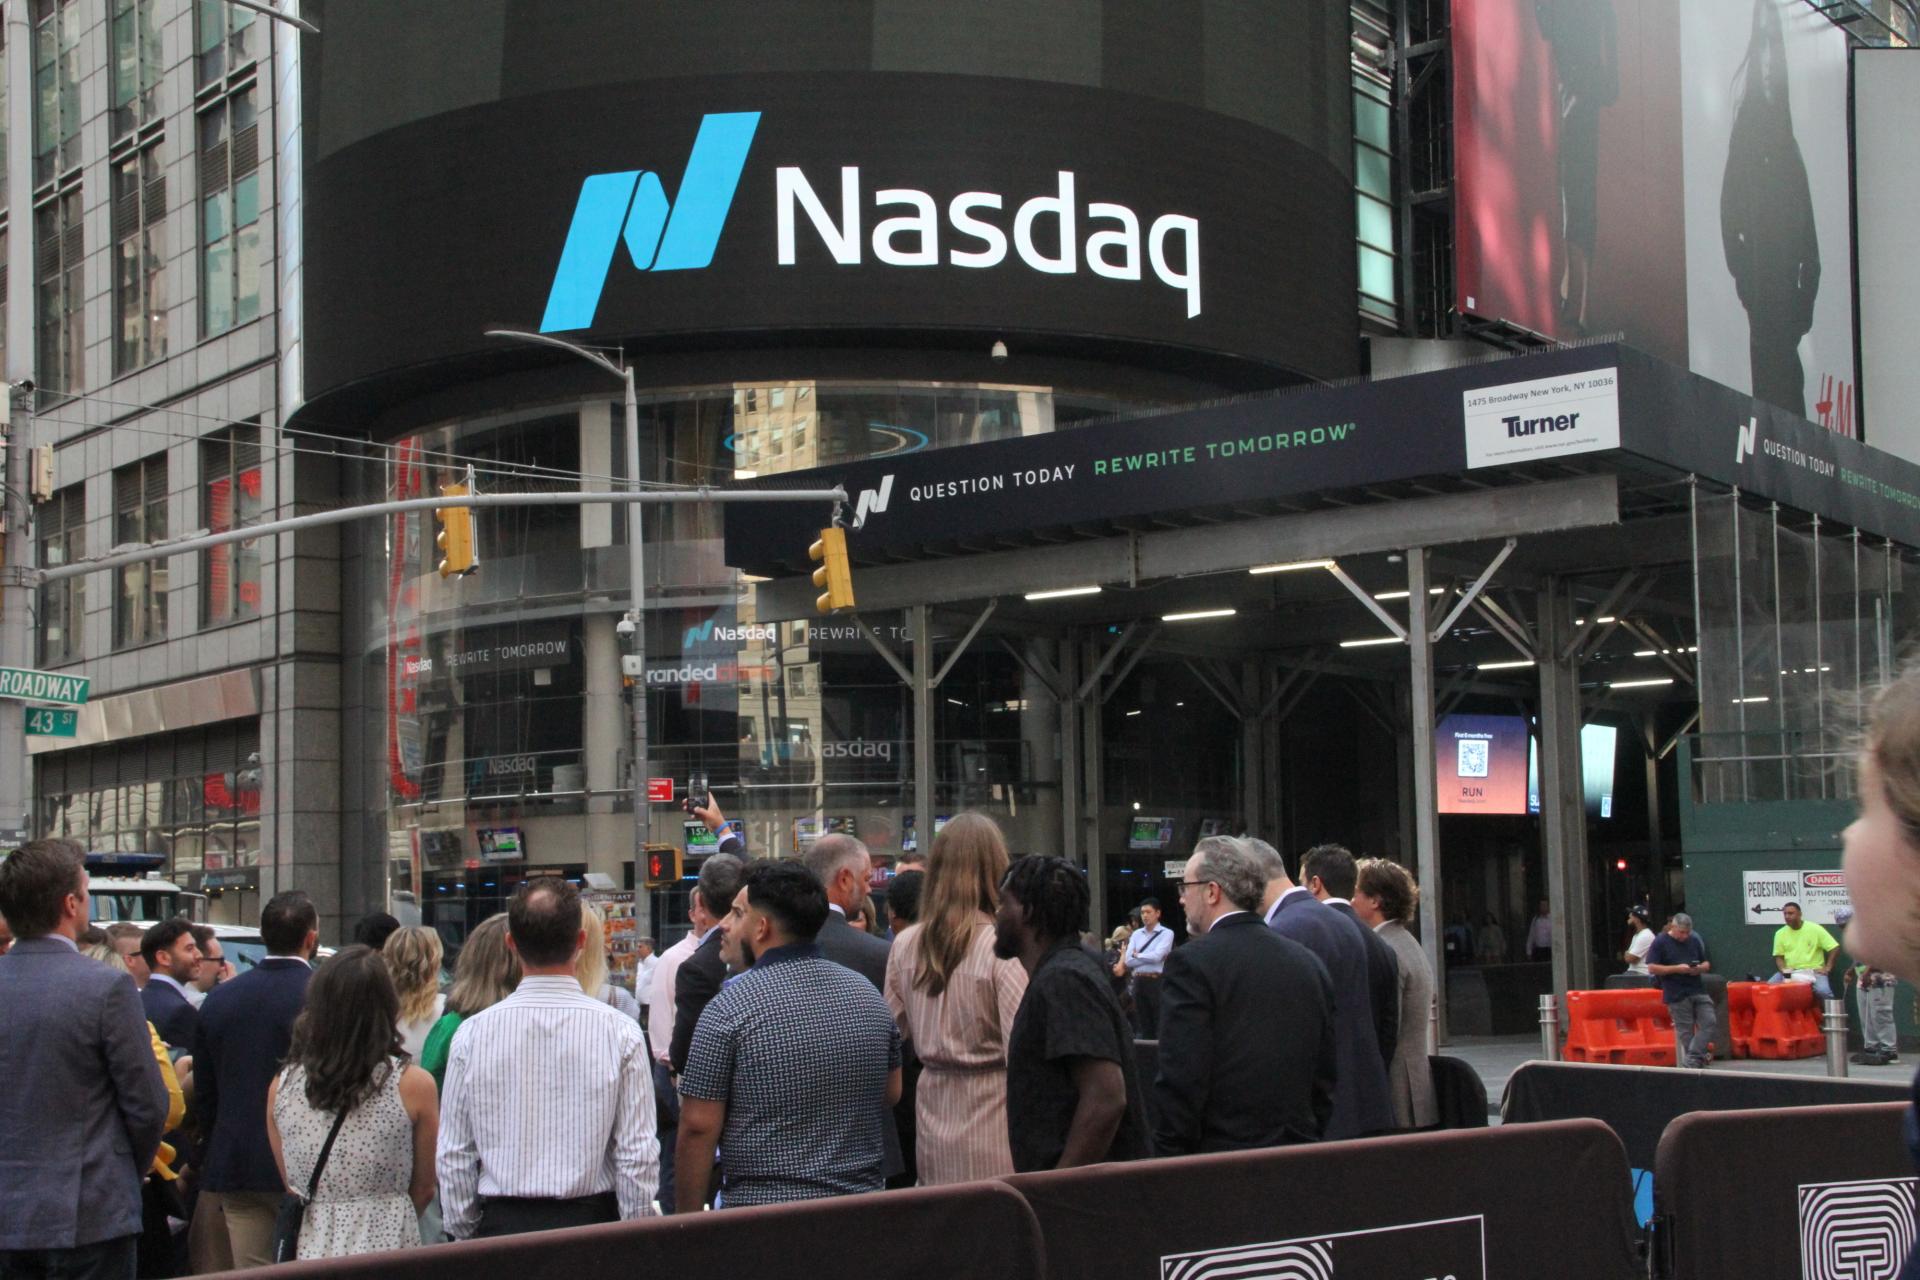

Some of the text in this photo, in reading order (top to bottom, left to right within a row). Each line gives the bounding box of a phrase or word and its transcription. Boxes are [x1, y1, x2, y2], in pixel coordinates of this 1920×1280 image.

[776, 166, 1201, 319] Nasdaq
[1467, 376, 1614, 407] 1475 Broadway New York, NY 10036
[1502, 412, 1580, 438] Turner
[910, 475, 1003, 501] QUESTION
[1013, 464, 1075, 487] TODAY
[1094, 447, 1196, 475] REWRITE
[1763, 438, 1920, 510] QUESTION TODAY REWRITE TOMORRO
[714, 626, 776, 643] Nasdaq
[809, 627, 881, 640] REWRIE
[0, 671, 85, 702] ROADWAY
[30, 711, 73, 733] 43 ST
[489, 756, 536, 776] Nasdaq
[1462, 787, 1483, 797] RUN
[1748, 881, 1797, 897] PEDESTRIANS
[1810, 875, 1842, 884] DANGE
[1806, 889, 1849, 897] AUTHORIZ
